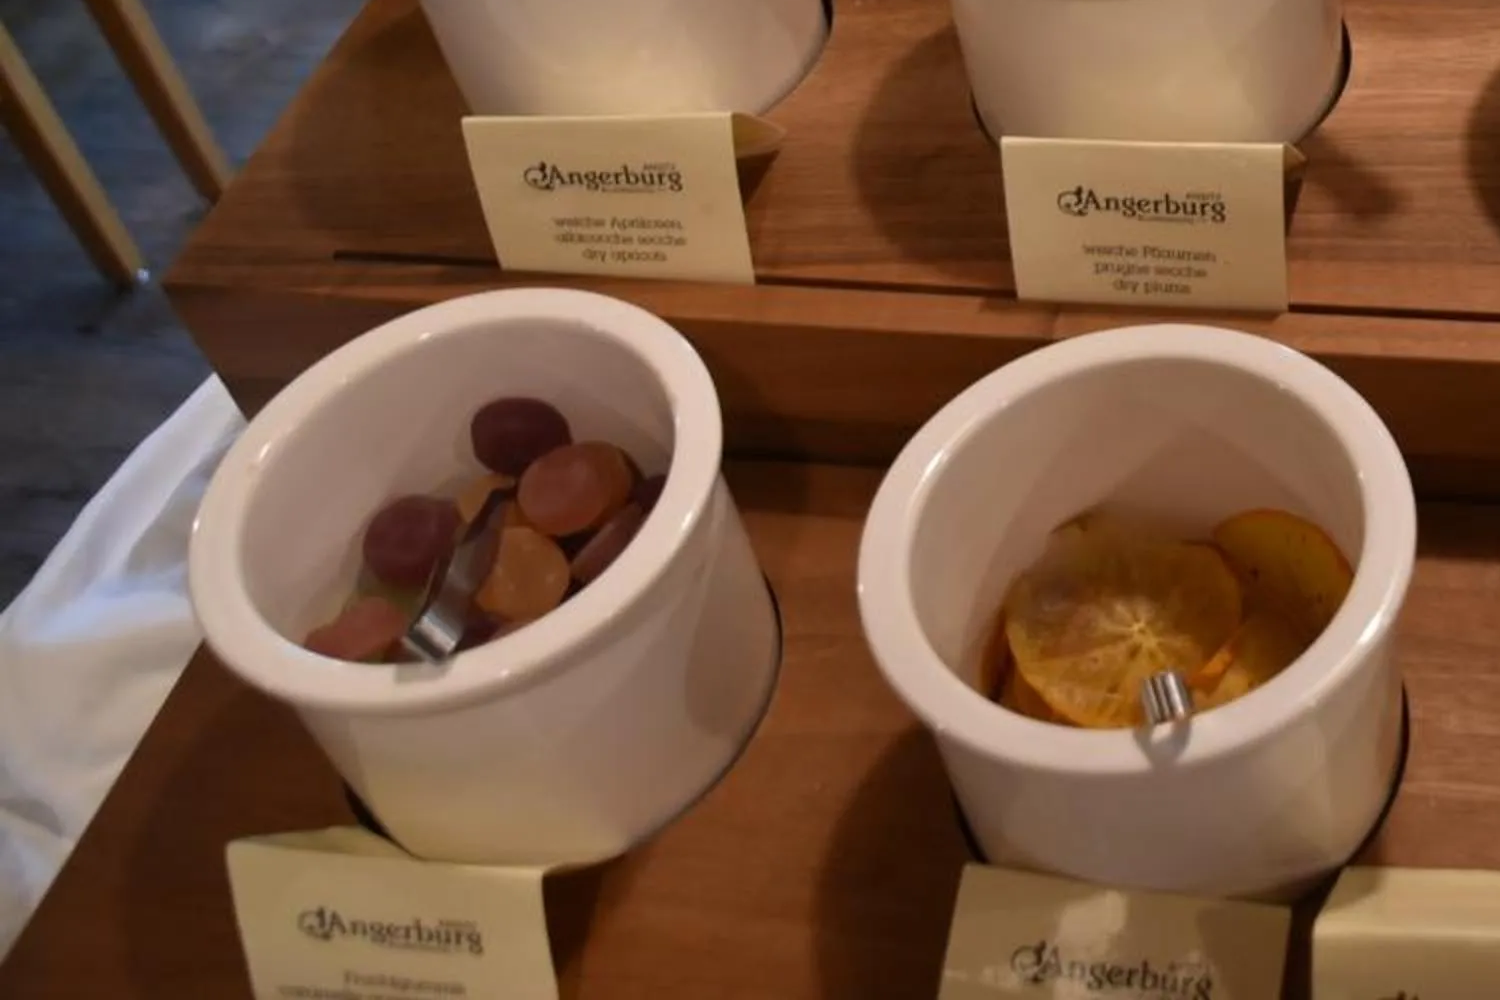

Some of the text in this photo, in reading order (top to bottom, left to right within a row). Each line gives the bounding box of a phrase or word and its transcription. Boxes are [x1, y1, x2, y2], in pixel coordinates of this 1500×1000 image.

[524, 161, 684, 191] Angerburg
[1057, 186, 1226, 224] Angerburg
[582, 248, 606, 263] dry
[1113, 279, 1140, 294] dry
[298, 906, 484, 957] Angerburg
[1011, 940, 1213, 1000] Angerburg
